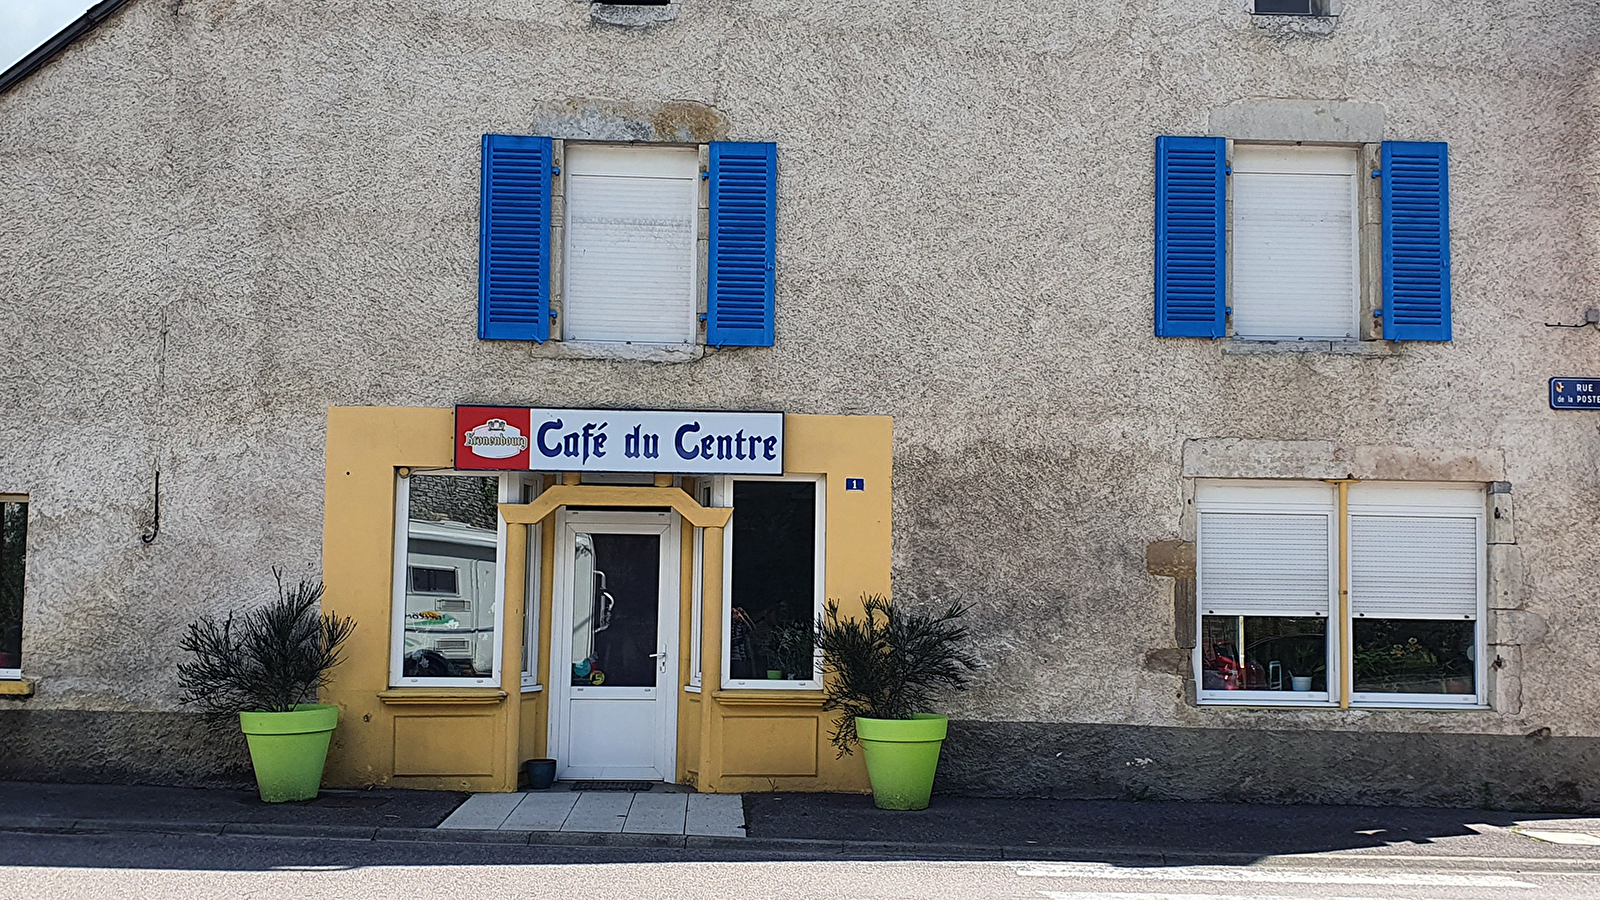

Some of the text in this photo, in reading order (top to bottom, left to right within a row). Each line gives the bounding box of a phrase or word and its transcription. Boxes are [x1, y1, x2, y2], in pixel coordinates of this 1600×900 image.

[1576, 384, 1593, 392] RUE
[1557, 395, 1600, 403] de la POSTE
[464, 432, 528, 450] Kronenbourg
[537, 418, 778, 466] Café du Centre
[852, 479, 857, 489] 1
